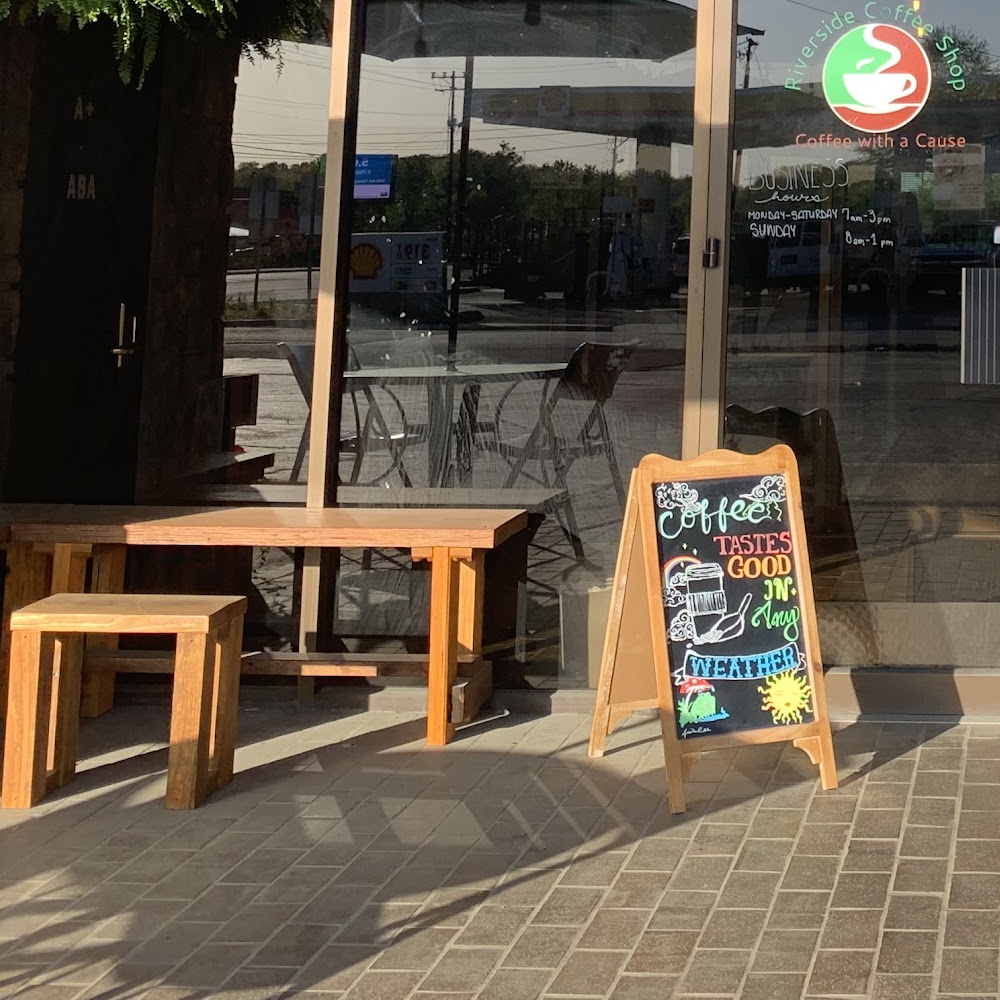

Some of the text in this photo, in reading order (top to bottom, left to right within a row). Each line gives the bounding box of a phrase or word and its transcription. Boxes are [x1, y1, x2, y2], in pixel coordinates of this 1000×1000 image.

[784, 1, 966, 92] Riverside Coffee Shop
[795, 133, 966, 149] Coffee with a Cause
[66, 173, 96, 200] ABA
[748, 157, 849, 191] BUSINESS
[754, 191, 830, 204] hours
[747, 208, 838, 221] MONDAY-SATURDAY
[749, 222, 797, 239] SUNDAY
[713, 530, 793, 556] TASTES
[727, 554, 792, 579] GOOD
[751, 601, 800, 642] Any
[689, 646, 799, 679] WEATHER
